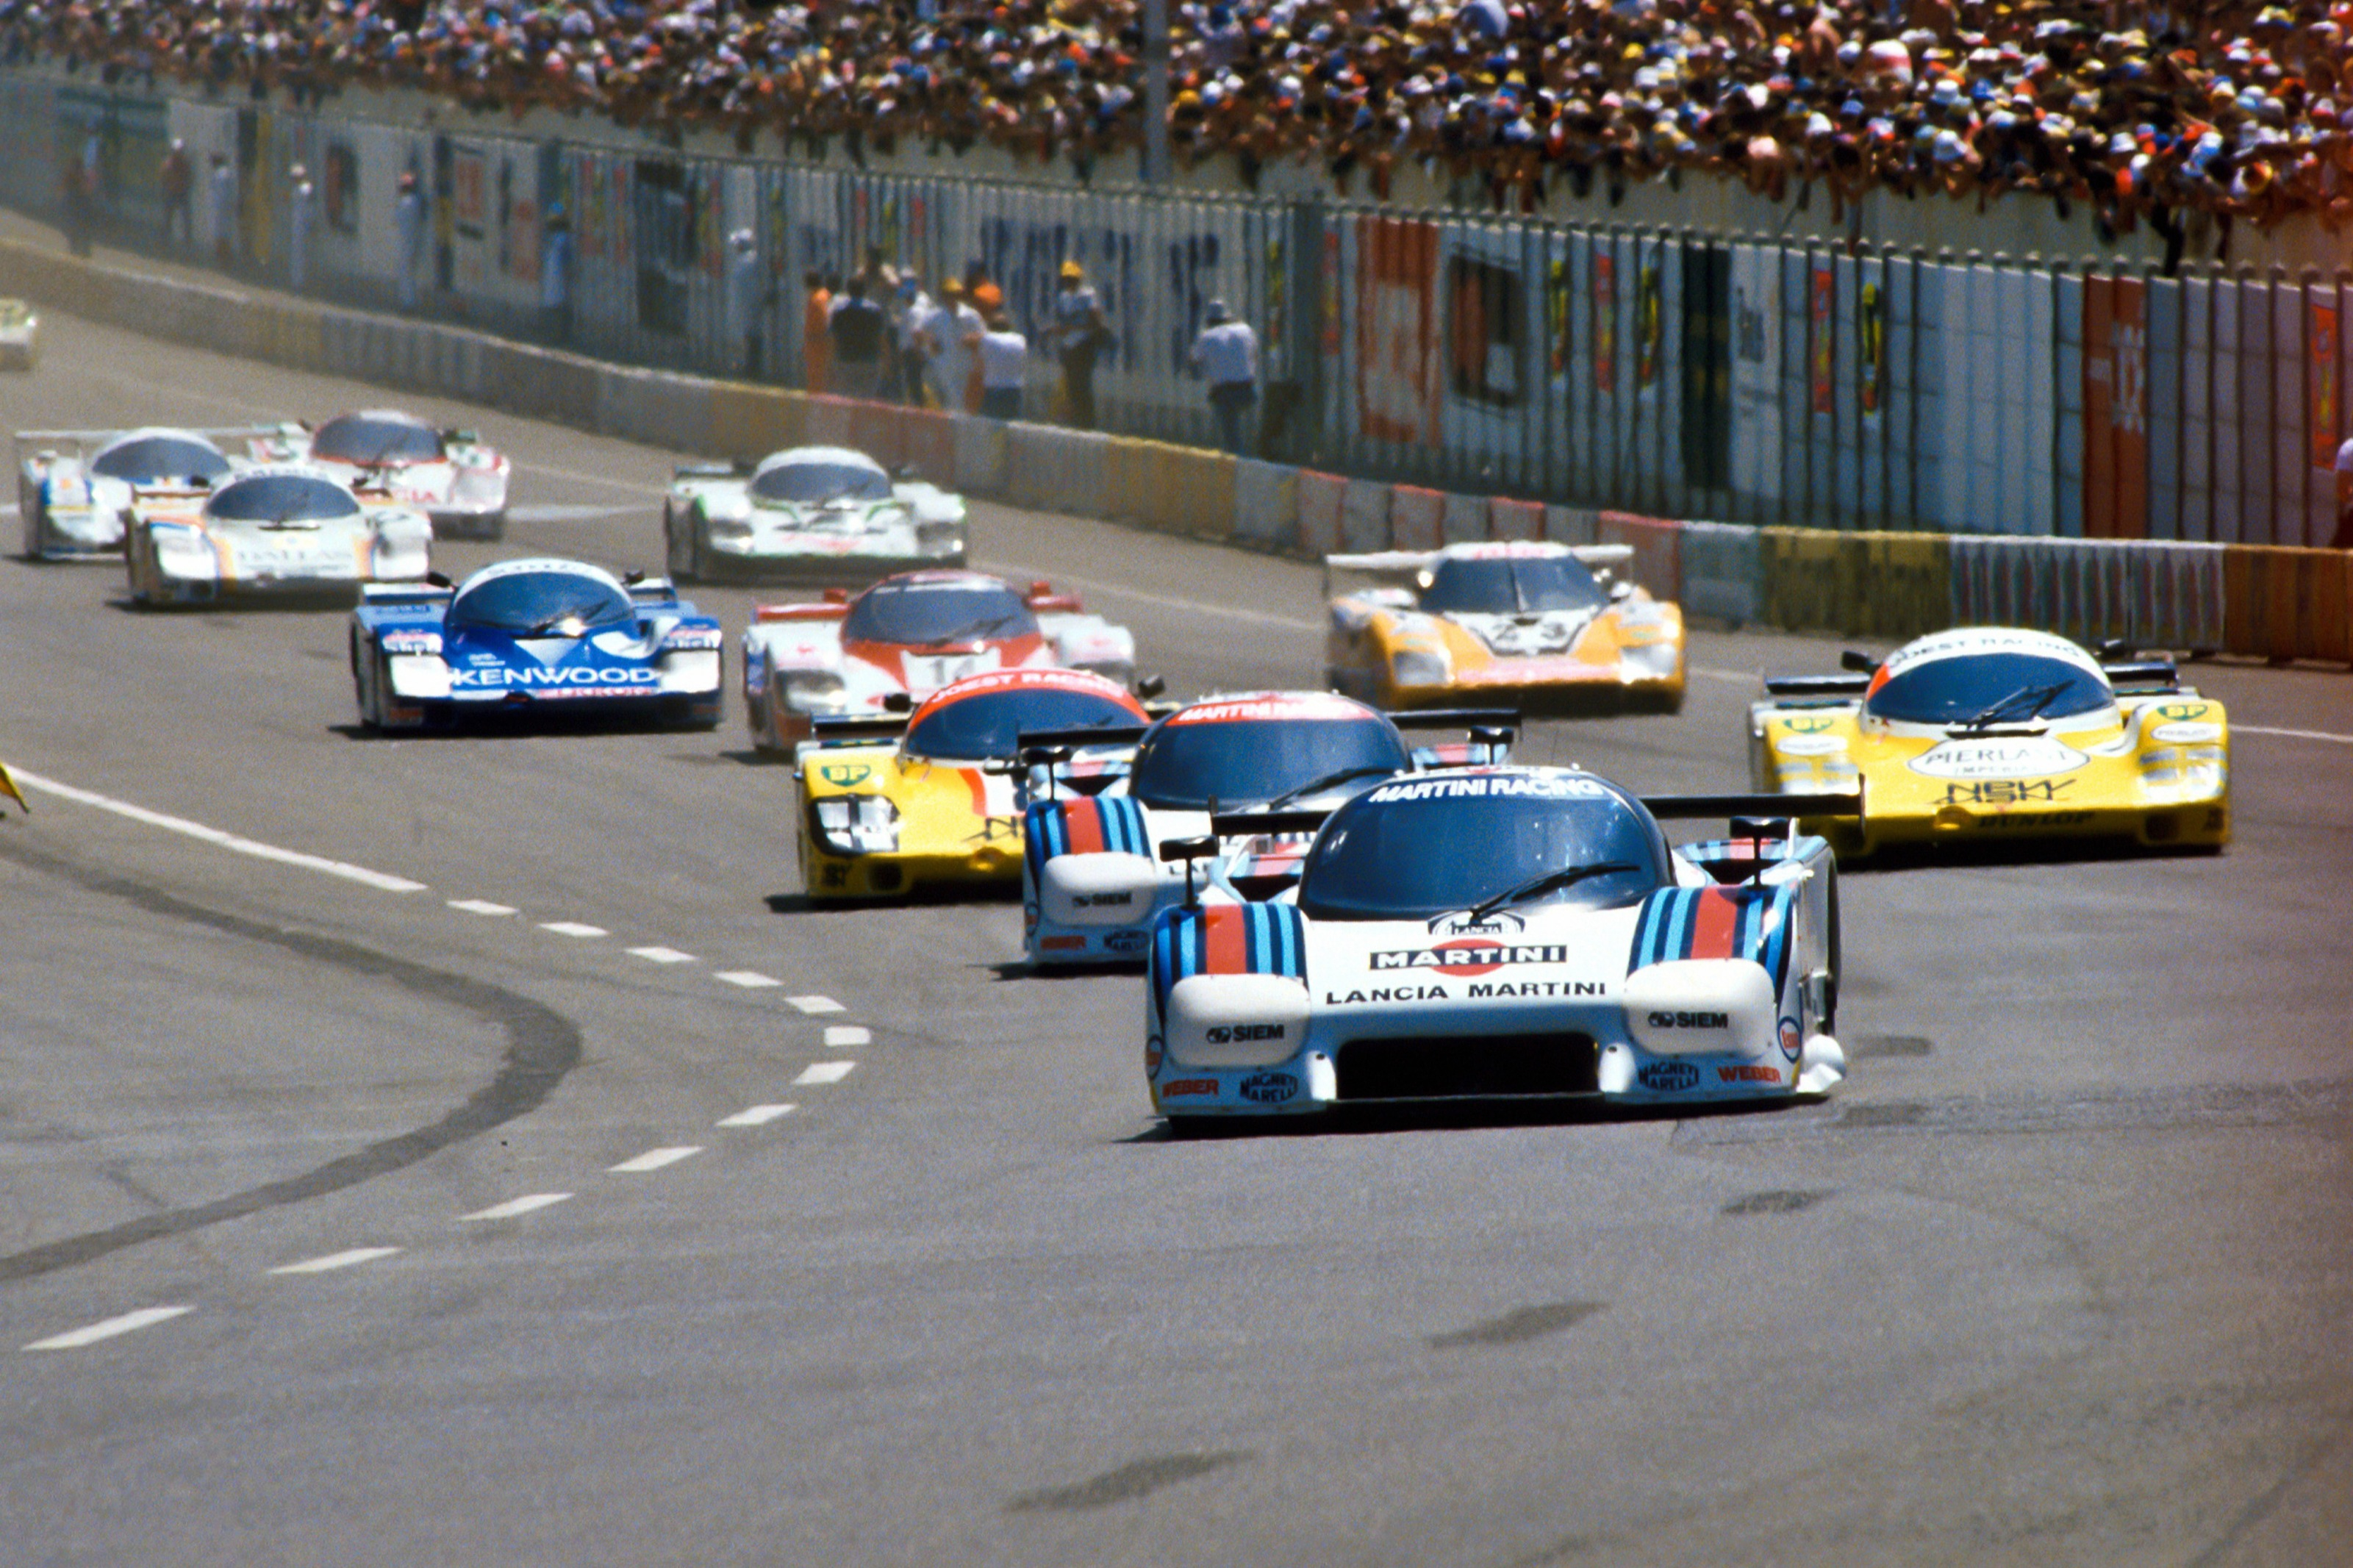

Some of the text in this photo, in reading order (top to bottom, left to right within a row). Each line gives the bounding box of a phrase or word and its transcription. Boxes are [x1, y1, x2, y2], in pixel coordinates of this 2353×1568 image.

[453, 667, 656, 685] KENWOOD
[825, 765, 868, 783] BP
[1369, 778, 1603, 802] MARTINI RACING
[1454, 925, 1501, 934] LANCIA
[1376, 945, 1561, 969] MARTINI
[1326, 981, 1605, 1005] LANCIA MARTINI
[1677, 1012, 1728, 1028] SIEM
[1233, 1024, 1285, 1042] SIEM
[1718, 1065, 1781, 1083] WEBER
[1162, 1078, 1219, 1098] WEBER
